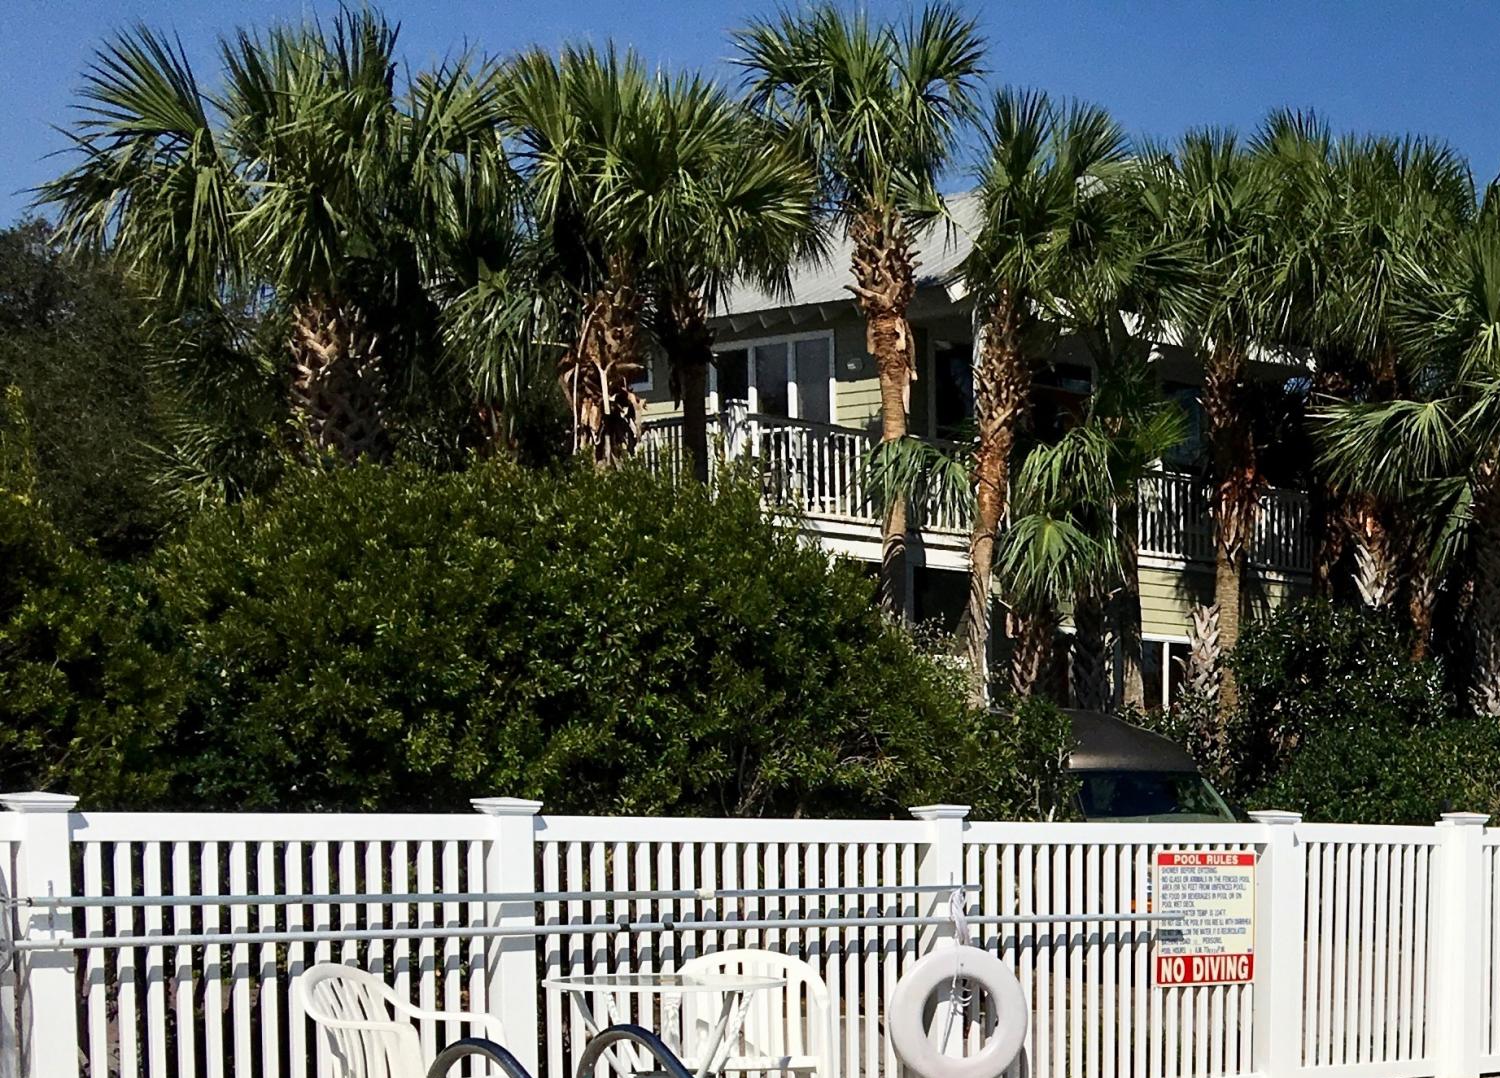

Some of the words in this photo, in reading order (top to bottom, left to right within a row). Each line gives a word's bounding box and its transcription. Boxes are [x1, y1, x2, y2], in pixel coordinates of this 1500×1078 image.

[1174, 855, 1202, 864] POOL
[1207, 855, 1238, 864] RULES
[1161, 957, 1186, 983] NO
[1192, 955, 1249, 982] DIVING
